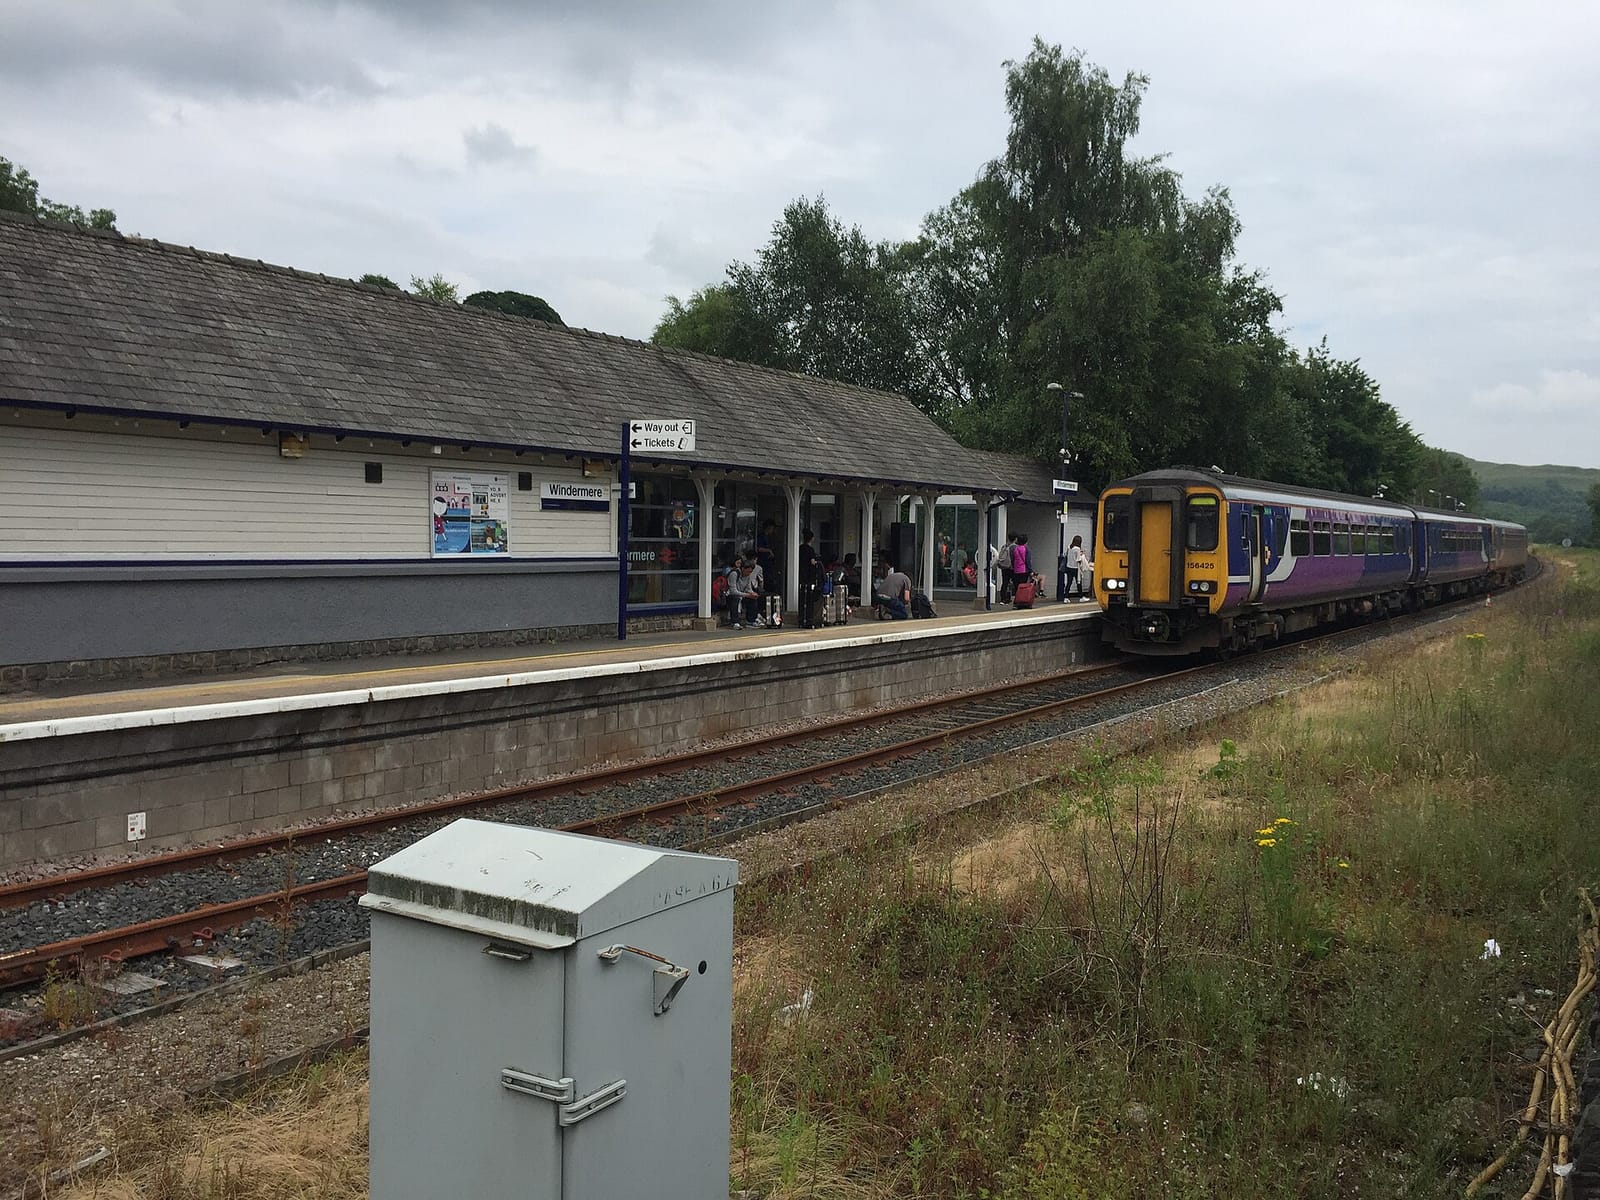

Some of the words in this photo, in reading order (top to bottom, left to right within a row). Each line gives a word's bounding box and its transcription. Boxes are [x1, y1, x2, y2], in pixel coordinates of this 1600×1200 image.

[644, 423, 663, 434] Way
[665, 422, 679, 432] out
[644, 437, 675, 448] Tickets
[549, 483, 603, 498] Windermere
